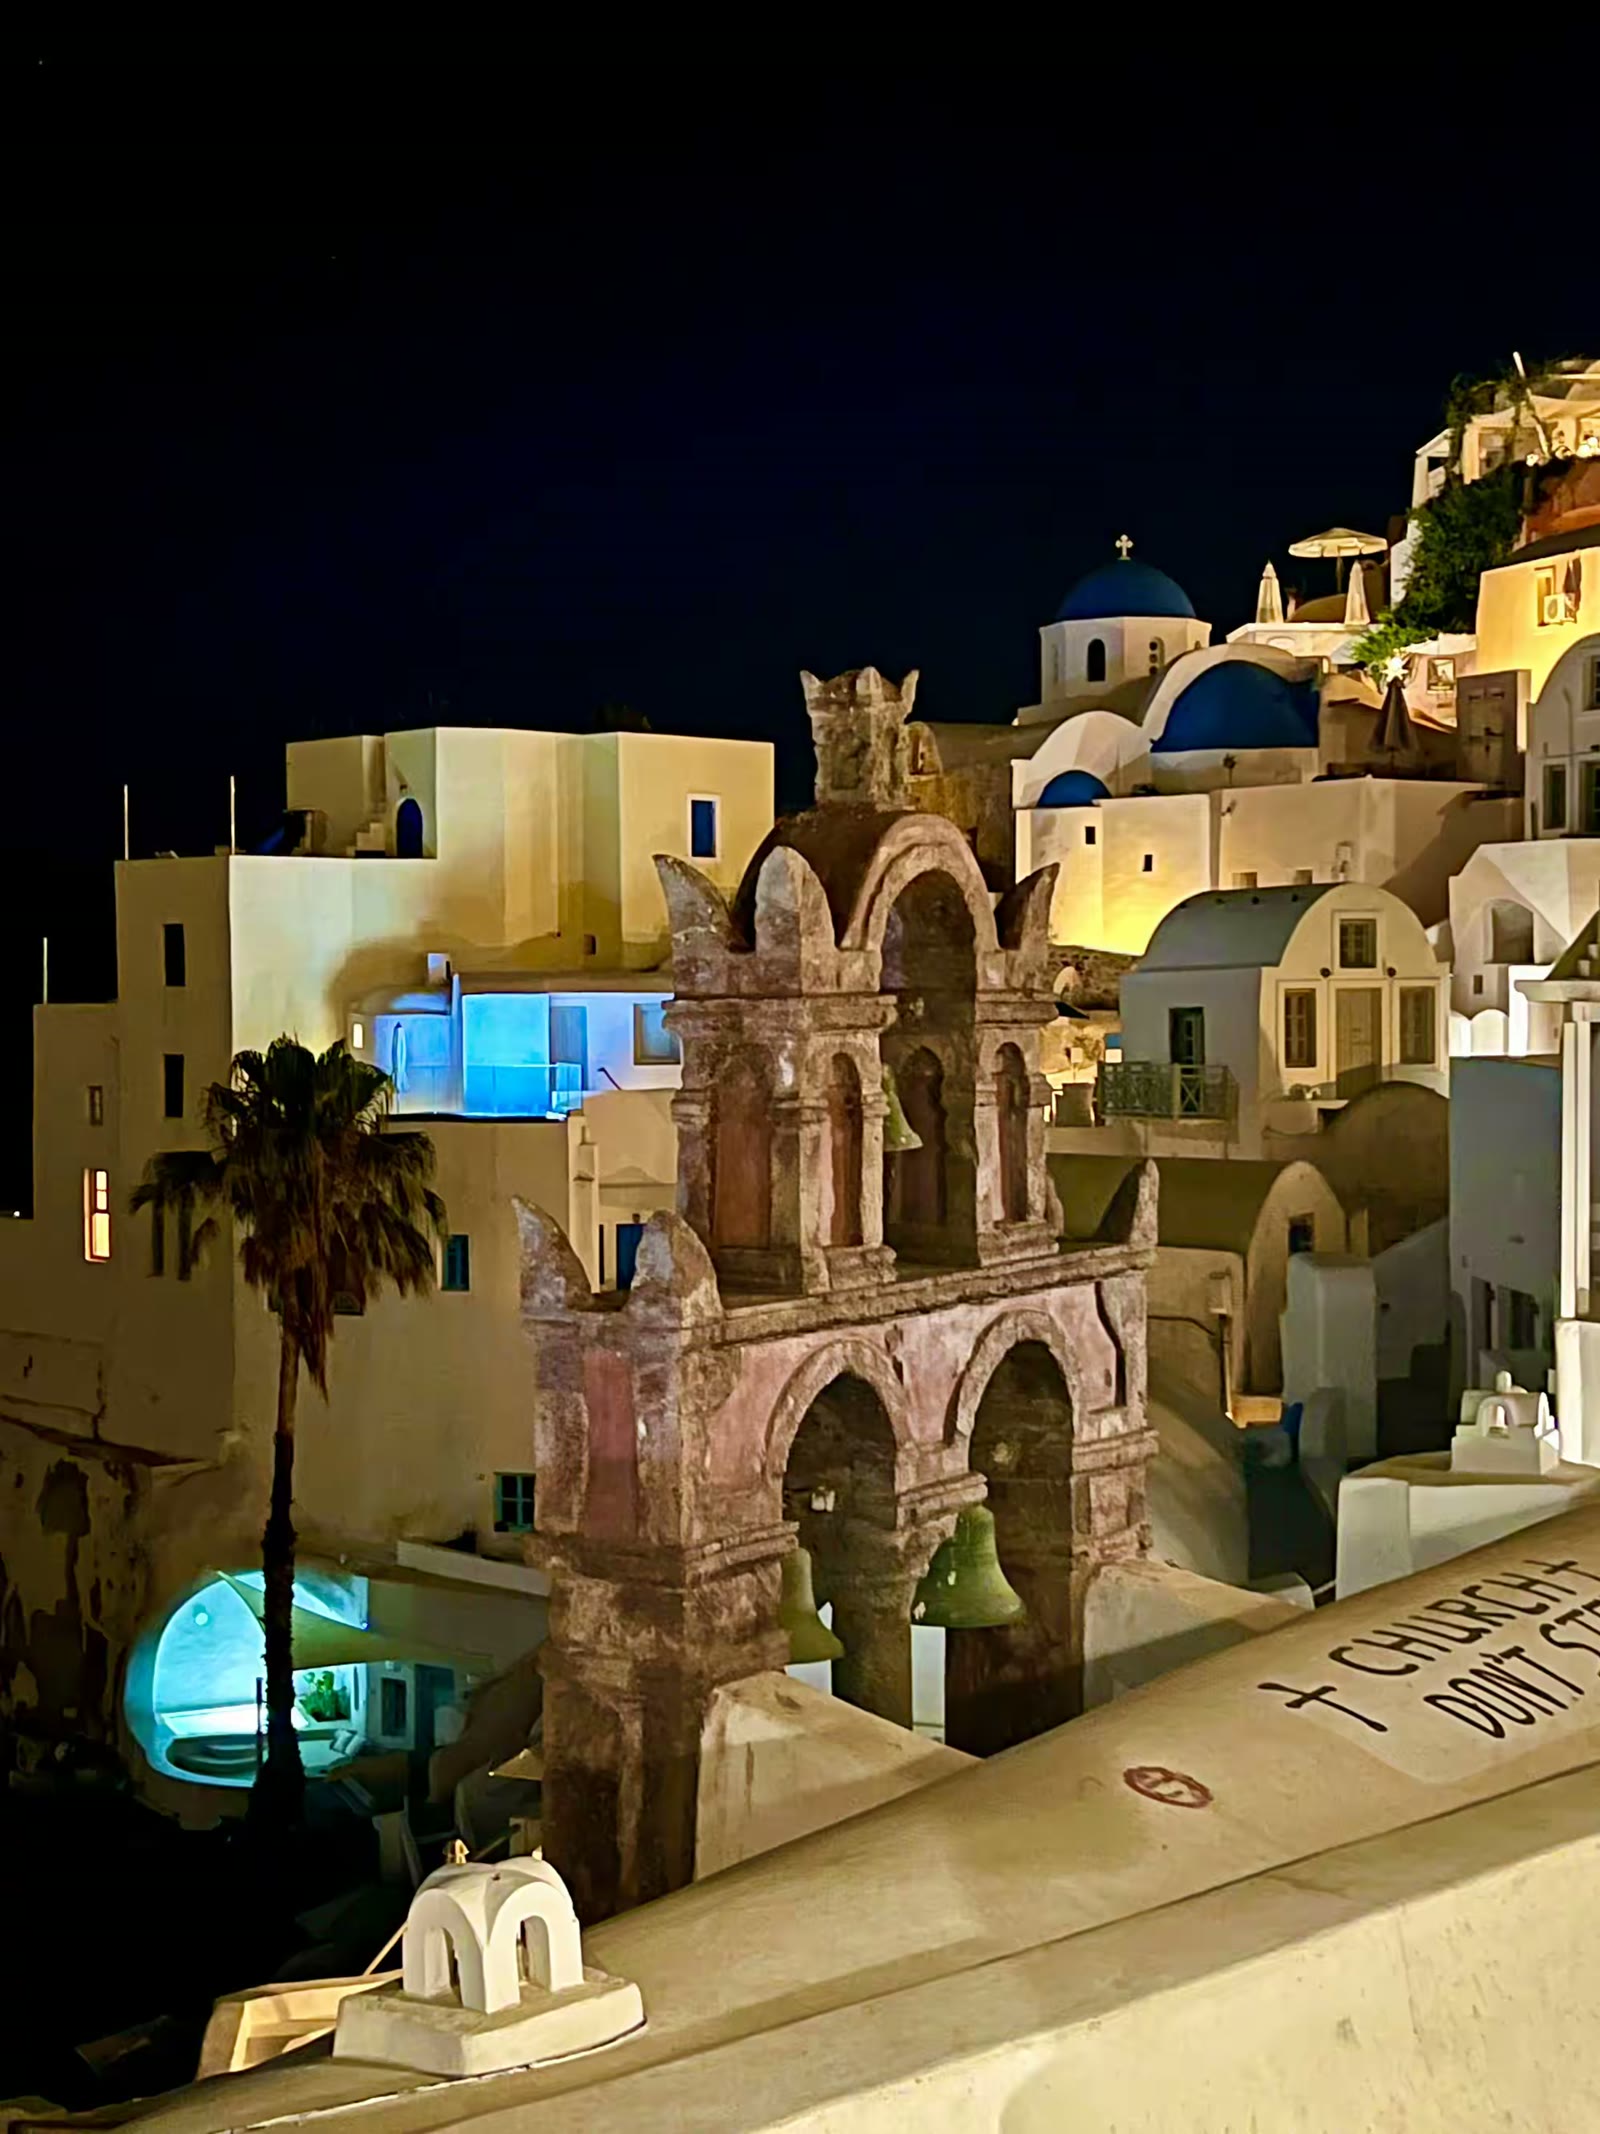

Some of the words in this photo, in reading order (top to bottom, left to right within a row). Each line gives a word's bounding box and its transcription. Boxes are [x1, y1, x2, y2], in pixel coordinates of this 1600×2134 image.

[1328, 1572, 1577, 1676] CHURCH
[1423, 1646, 1584, 1739] DON'T
[1539, 1599, 1600, 1677] ST
